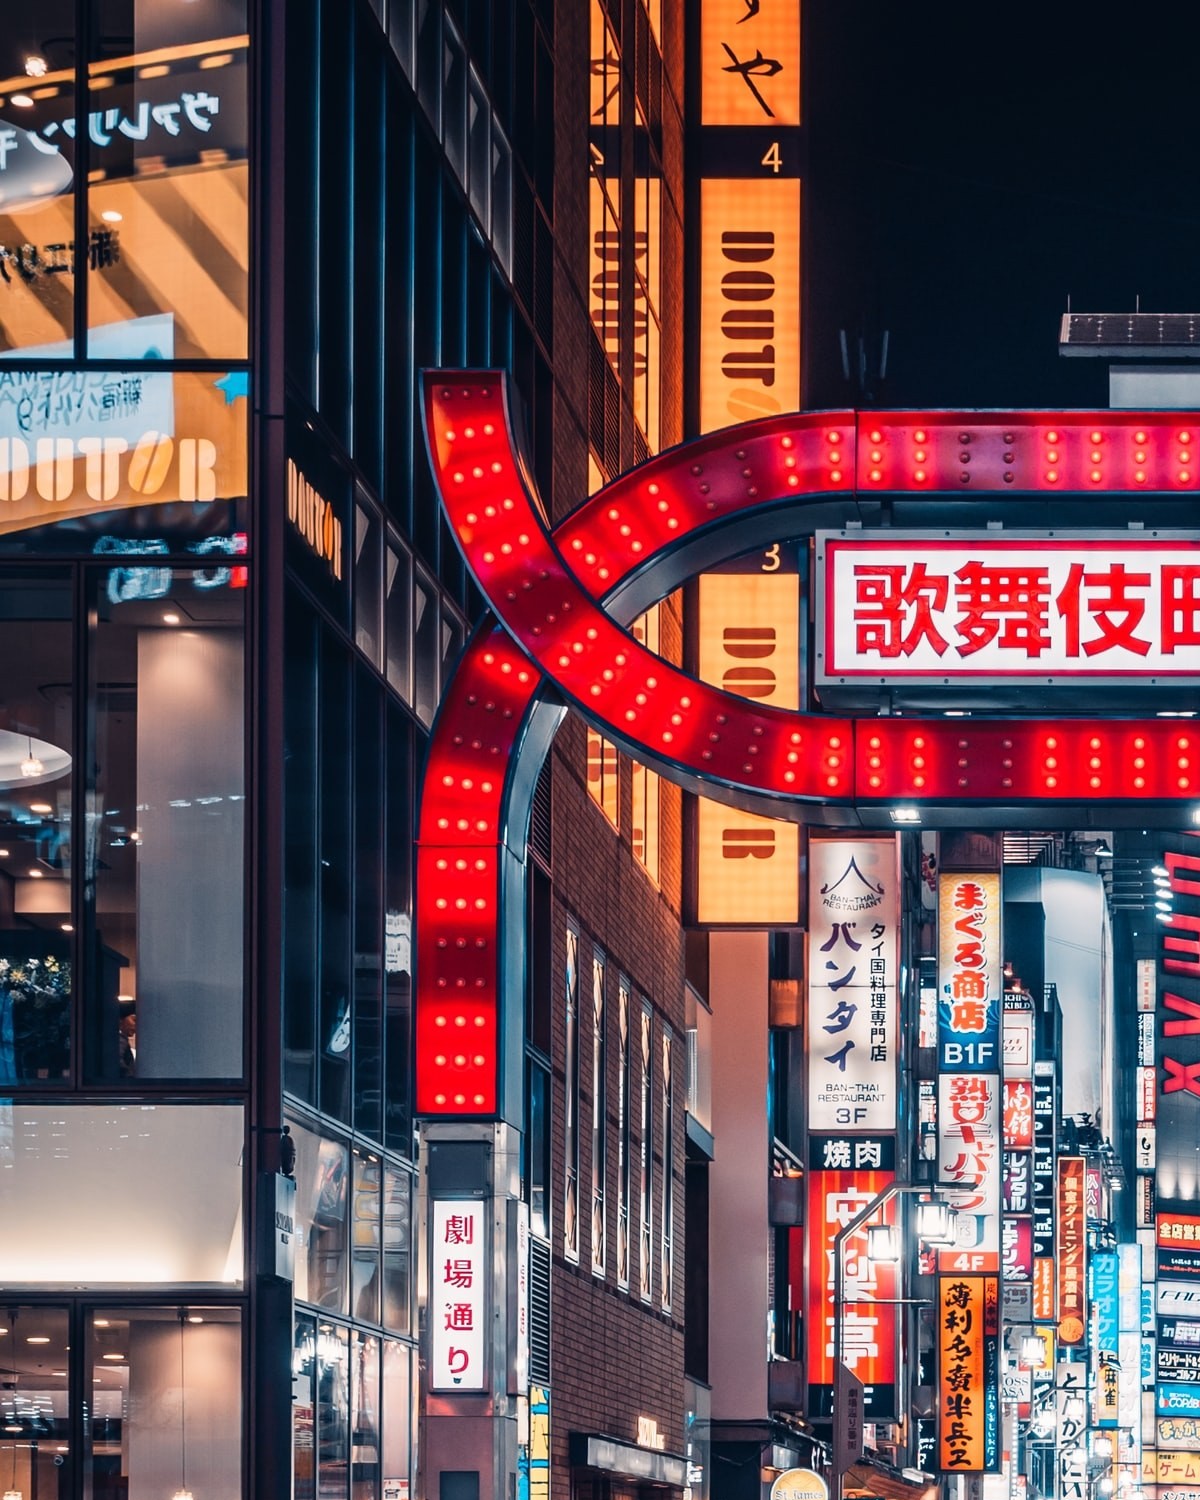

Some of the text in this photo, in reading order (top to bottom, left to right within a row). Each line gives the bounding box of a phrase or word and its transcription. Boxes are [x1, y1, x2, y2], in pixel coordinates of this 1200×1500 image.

[762, 142, 784, 174] 4
[952, 882, 988, 1034] まぐろ商店
[820, 922, 863, 1073] バンタイ
[869, 922, 888, 1063] タイ国料理専門店
[943, 1043, 997, 1065] B1F
[818, 1093, 887, 1103] RESTAURANT
[826, 1083, 880, 1093] BAN-THAI
[835, 1108, 868, 1124] 3F
[823, 1140, 882, 1169] 焼肉
[953, 1253, 985, 1271] 4F
[443, 1214, 475, 1374] 劇場通り
